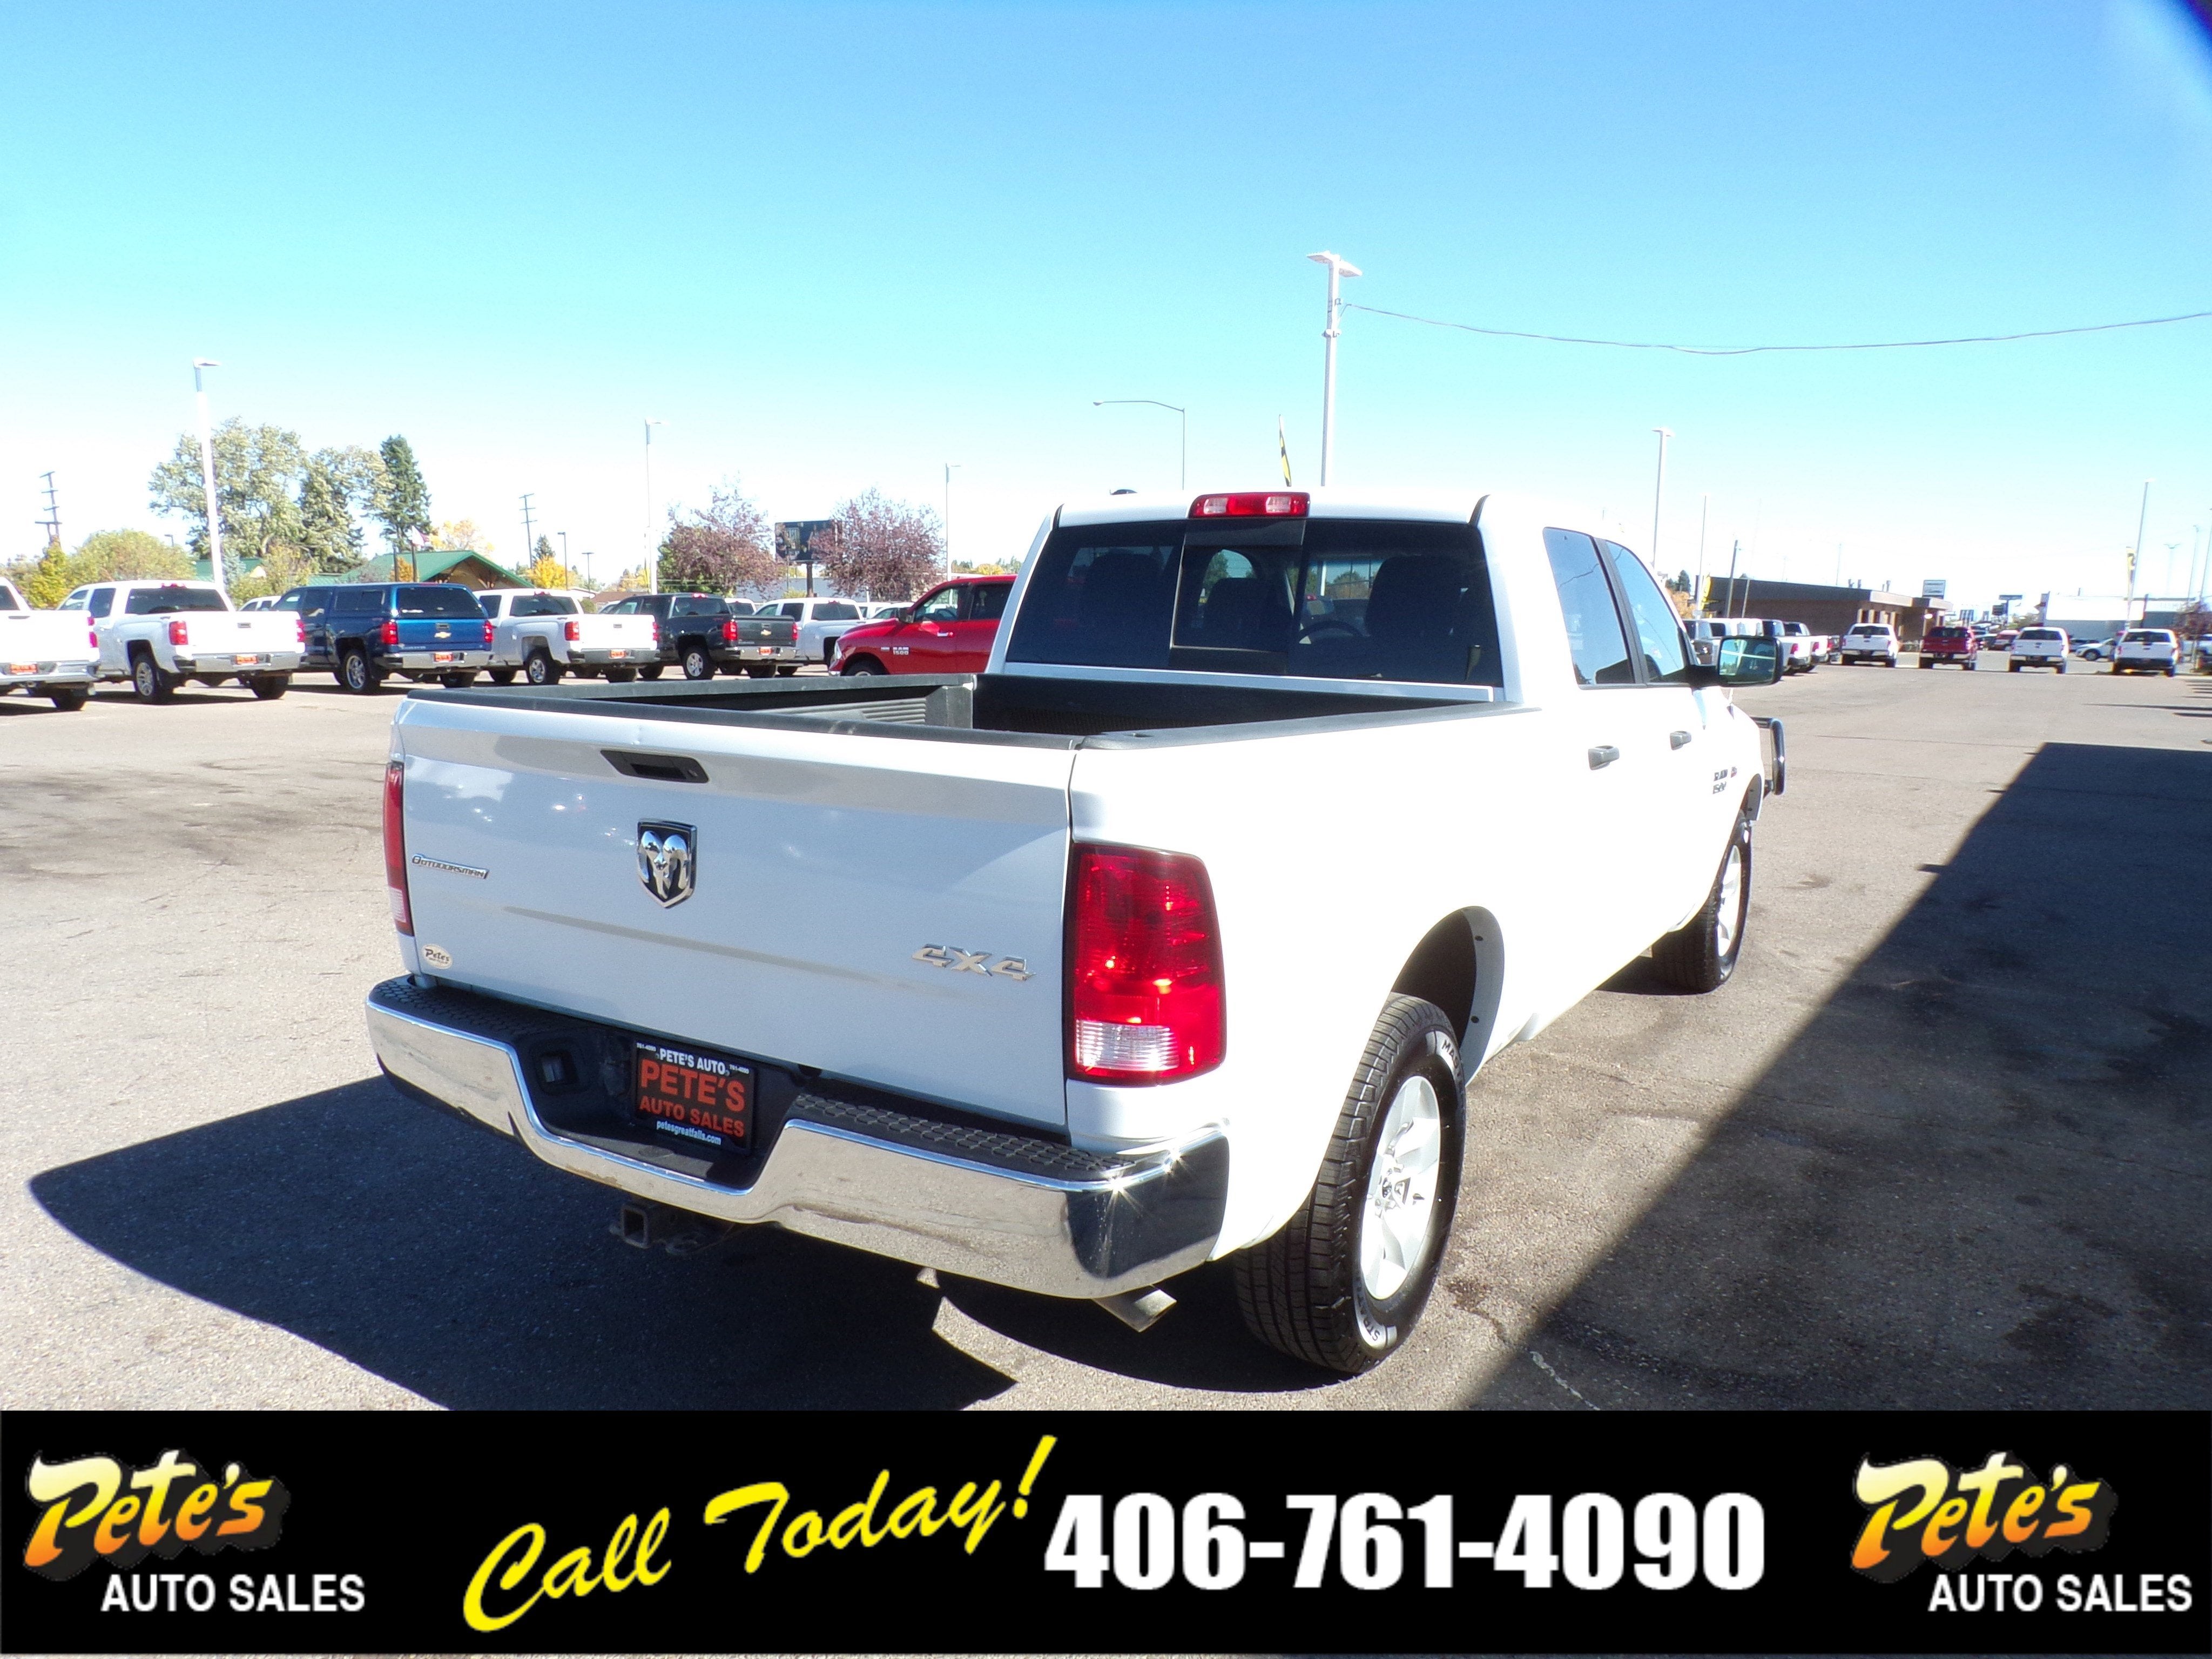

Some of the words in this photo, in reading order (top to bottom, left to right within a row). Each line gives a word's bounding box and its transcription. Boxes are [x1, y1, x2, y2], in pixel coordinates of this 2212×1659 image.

[659, 1048, 695, 1068] PETE'S
[697, 1058, 726, 1075] AUTO
[641, 1058, 745, 1112] PETE'S
[639, 1095, 685, 1121] AUTO
[690, 1108, 745, 1138] SALES
